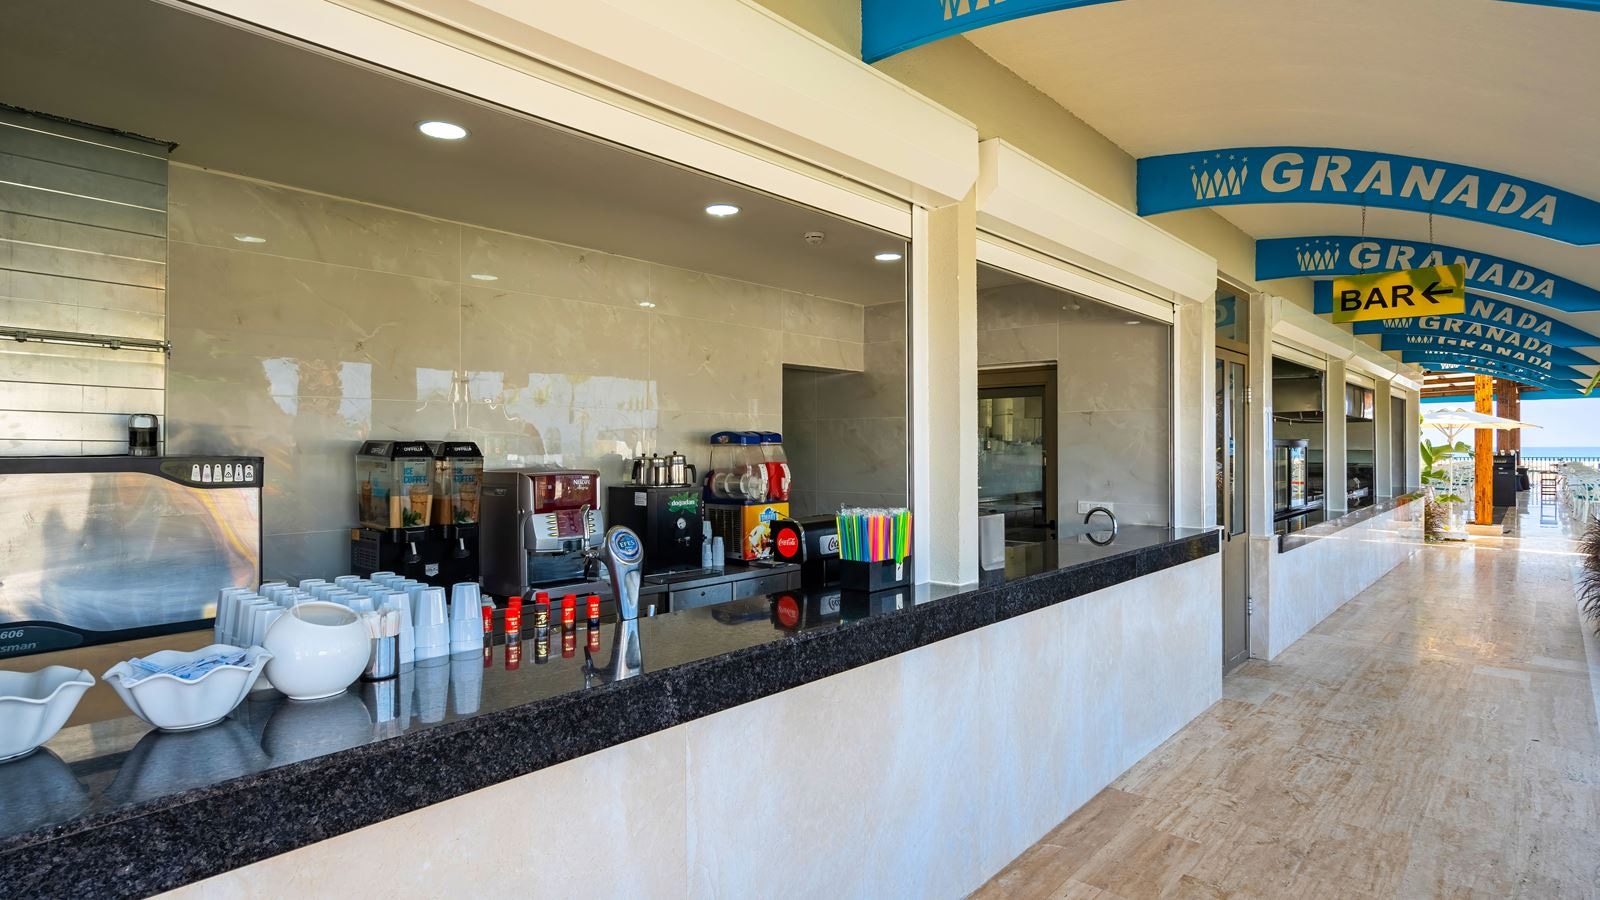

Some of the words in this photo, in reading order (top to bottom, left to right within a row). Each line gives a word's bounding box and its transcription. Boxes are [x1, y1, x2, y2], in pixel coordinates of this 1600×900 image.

[1260, 152, 1557, 226] GRANADA
[1349, 242, 1555, 299] GRANADA
[1340, 284, 1415, 312] BAR
[1470, 299, 1553, 336] NADA
[1418, 315, 1552, 357] GRANADA
[0, 629, 24, 639] 606
